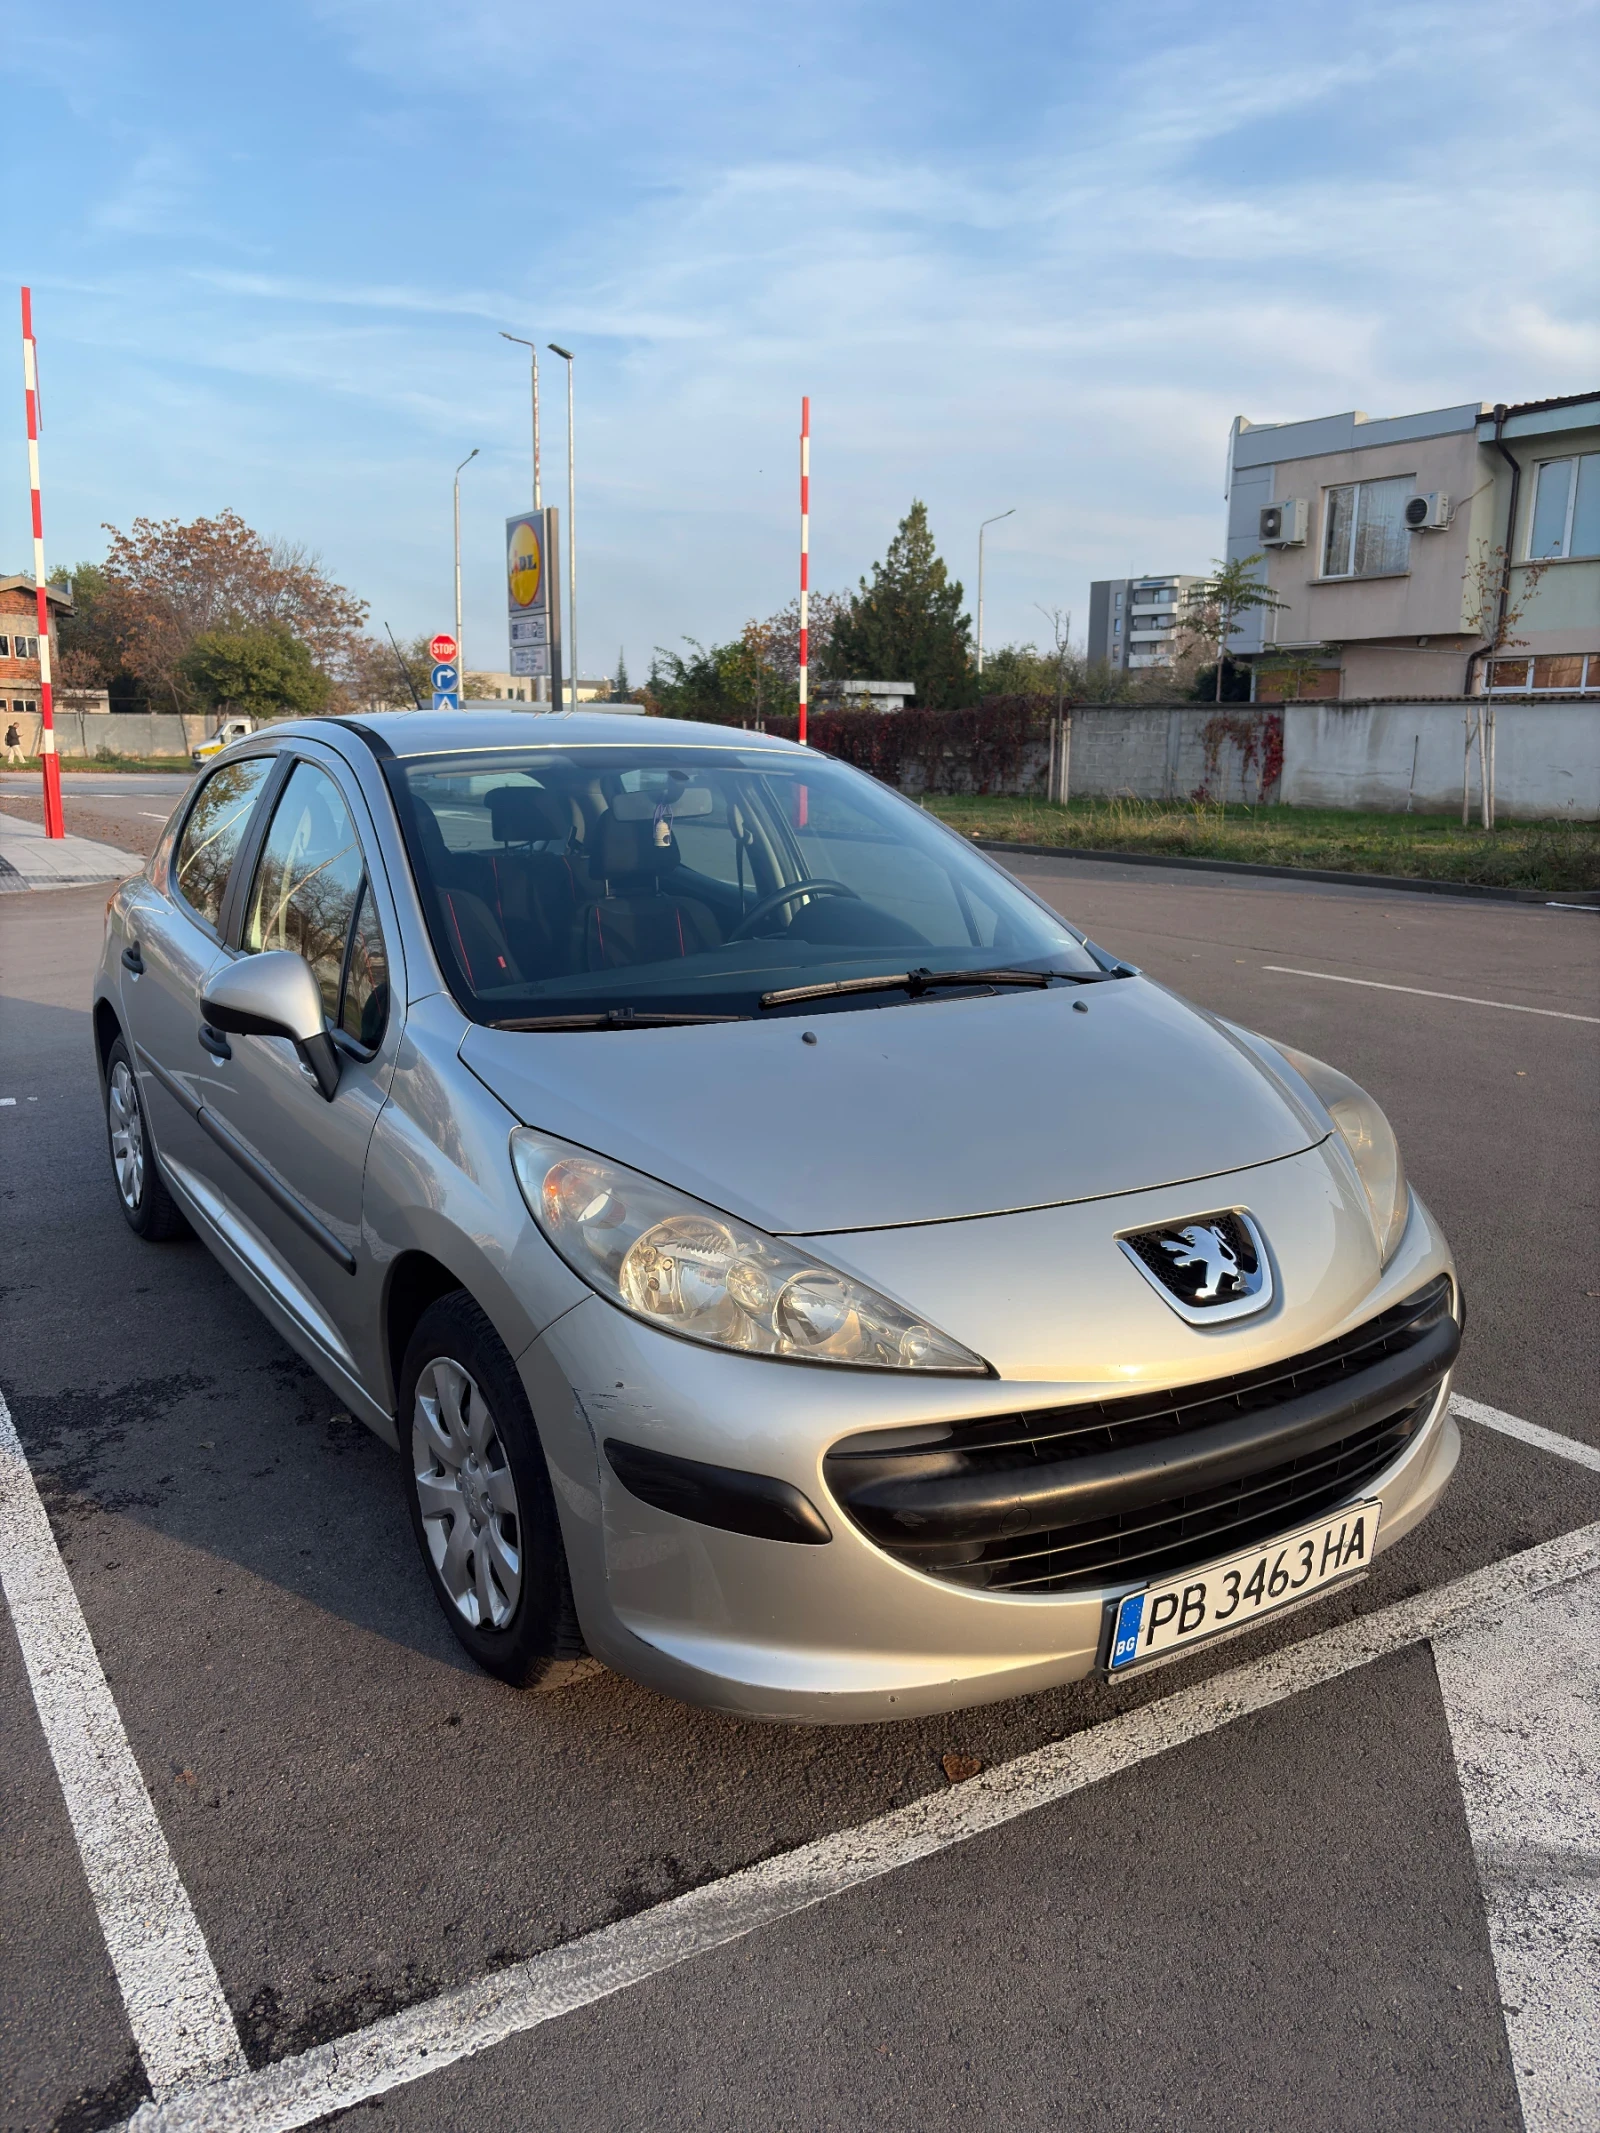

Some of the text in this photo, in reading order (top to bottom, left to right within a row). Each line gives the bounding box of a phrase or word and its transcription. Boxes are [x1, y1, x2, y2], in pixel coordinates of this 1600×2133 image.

[433, 643, 455, 655] STOP
[1146, 1517, 1364, 1646] PB 3463 HA
[1115, 1637, 1135, 1656] BG
[1122, 1661, 1163, 1679] PEUGEOT
[1169, 1649, 1190, 1662] AVTO
